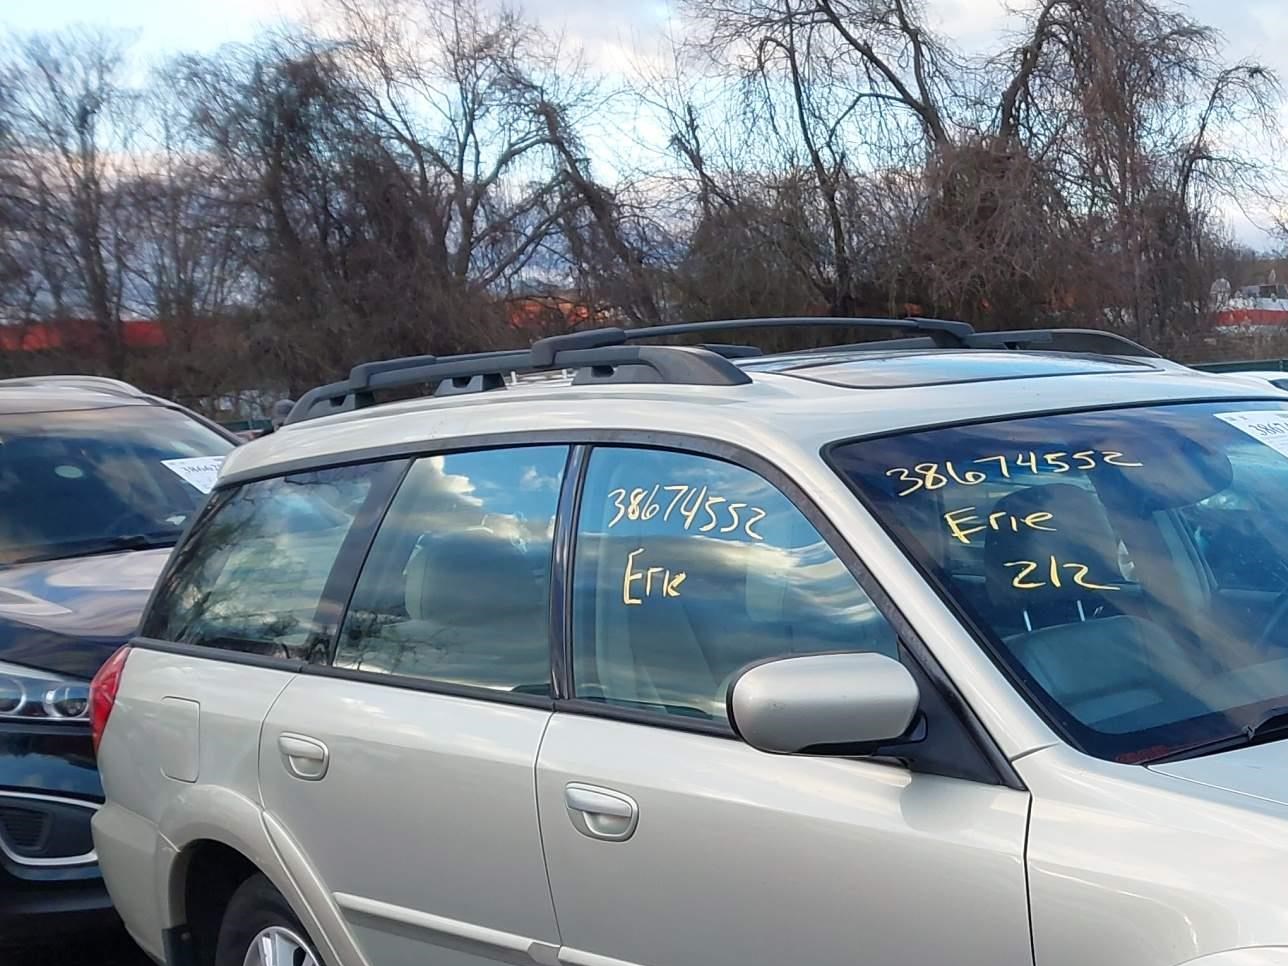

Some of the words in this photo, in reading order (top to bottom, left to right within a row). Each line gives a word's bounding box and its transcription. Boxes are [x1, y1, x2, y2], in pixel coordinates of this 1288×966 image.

[886, 451, 1144, 496] 38674552
[607, 484, 767, 540] 38674552
[944, 506, 1057, 544] Erie
